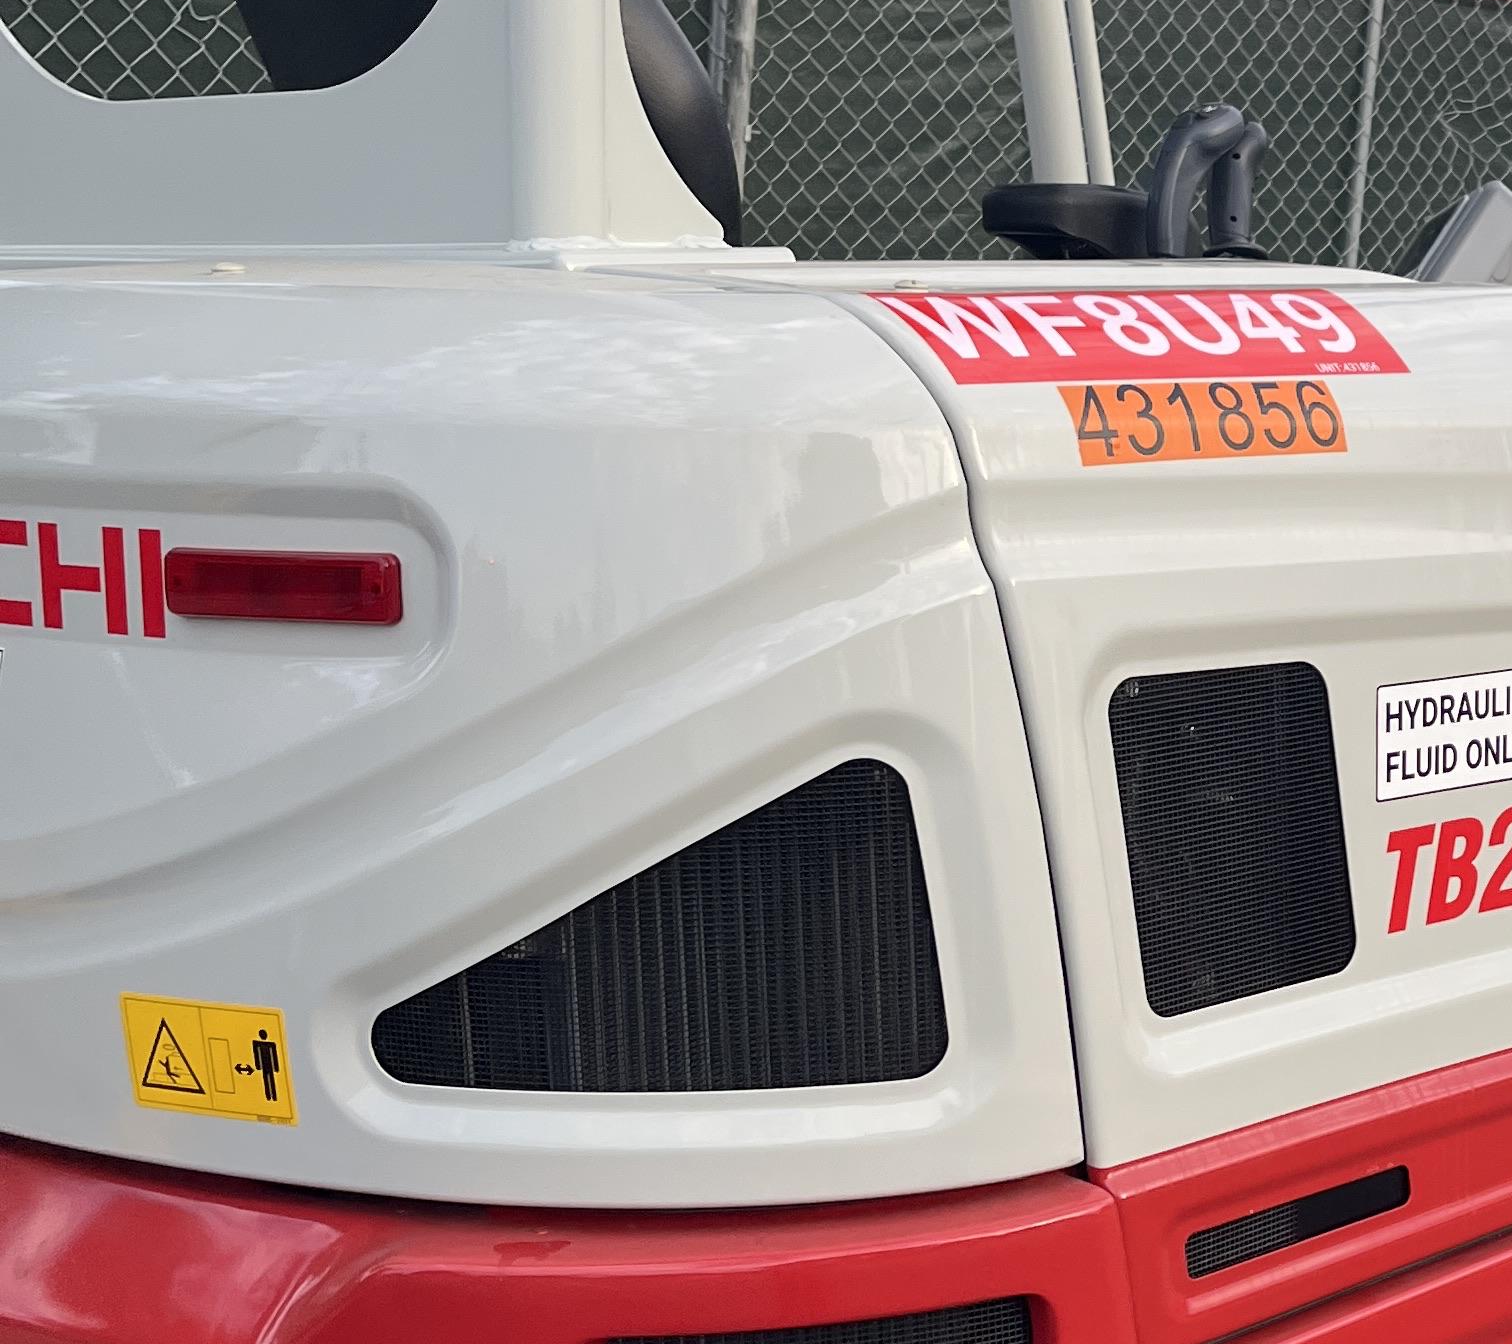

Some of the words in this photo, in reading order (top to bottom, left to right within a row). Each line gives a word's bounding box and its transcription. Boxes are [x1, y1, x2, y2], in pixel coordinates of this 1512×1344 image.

[878, 293, 1357, 359] WF8U49
[1078, 381, 1339, 457] 431856
[1386, 743, 1457, 783] FLUID
